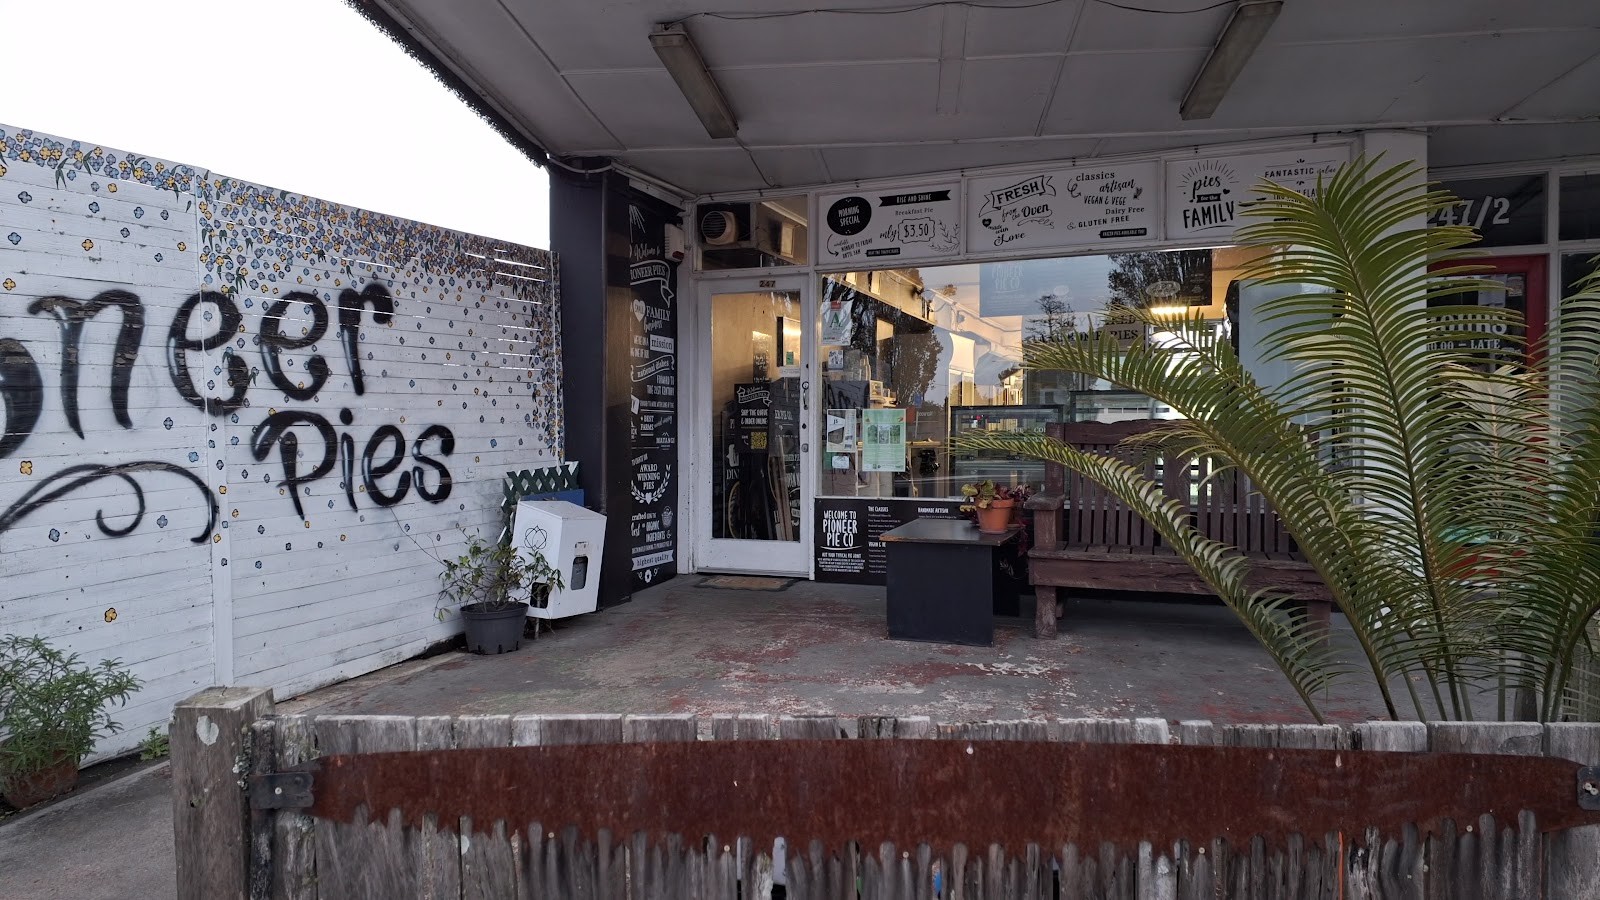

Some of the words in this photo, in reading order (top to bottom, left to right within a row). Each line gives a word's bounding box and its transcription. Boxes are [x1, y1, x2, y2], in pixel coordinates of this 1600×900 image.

[1075, 171, 1115, 182] classics
[1264, 167, 1314, 178] FANTASTIC
[1099, 178, 1136, 193] artisan
[1191, 175, 1221, 201] pies
[896, 196, 907, 204] RISE
[918, 193, 932, 202] SHINE
[996, 181, 1040, 205] FRESH
[1084, 195, 1104, 205] VEGAN
[1104, 195, 1110, 205] &
[1111, 196, 1127, 206] VEGE
[838, 205, 860, 218] MORNING
[895, 208, 923, 216] Breakfast
[1001, 207, 1018, 223] from
[1021, 203, 1049, 218] Oven
[1105, 207, 1126, 215] Dairy
[1183, 200, 1234, 229] FAMILY
[840, 215, 861, 227] SPECIAL
[1078, 218, 1107, 228] GLUTEN
[1110, 215, 1130, 223] FREE
[903, 223, 929, 238] $3.50
[993, 232, 1026, 247] Love
[630, 265, 653, 280] IONEER
[653, 264, 666, 277] PIES
[759, 280, 776, 288] 247
[646, 305, 671, 322] FAMILY
[651, 338, 673, 351] mission
[1470, 339, 1501, 350] LATE
[643, 415, 654, 423] BEST
[250, 407, 456, 521] Pies
[639, 463, 658, 473] AWARD
[637, 472, 661, 482] WINNING
[642, 481, 655, 491] PIES
[823, 510, 848, 520] WELCOME
[849, 510, 857, 519] TO
[822, 518, 858, 534] PIONEER
[827, 532, 841, 547] PIE
[843, 532, 854, 547] CO
[636, 557, 654, 567] highest
